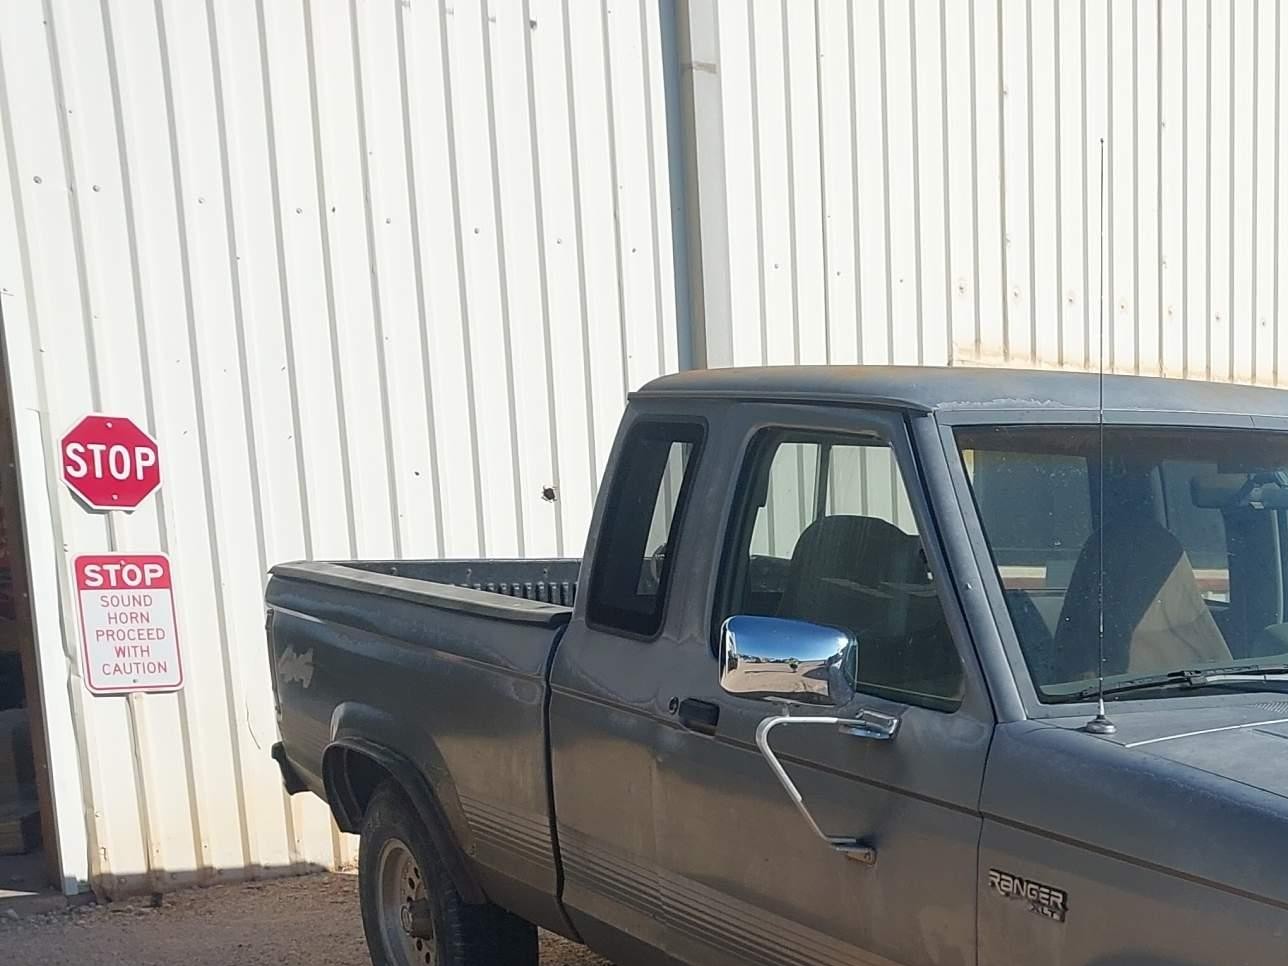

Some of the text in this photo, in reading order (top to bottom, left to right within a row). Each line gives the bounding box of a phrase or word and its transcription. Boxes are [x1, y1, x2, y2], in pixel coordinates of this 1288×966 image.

[65, 442, 156, 481] STOP
[84, 563, 164, 587] STOP
[100, 594, 153, 608] SOUND
[107, 611, 151, 625] HORN
[95, 628, 166, 642] PROCEED
[114, 645, 151, 658] WITH
[102, 661, 168, 676] CAUTION
